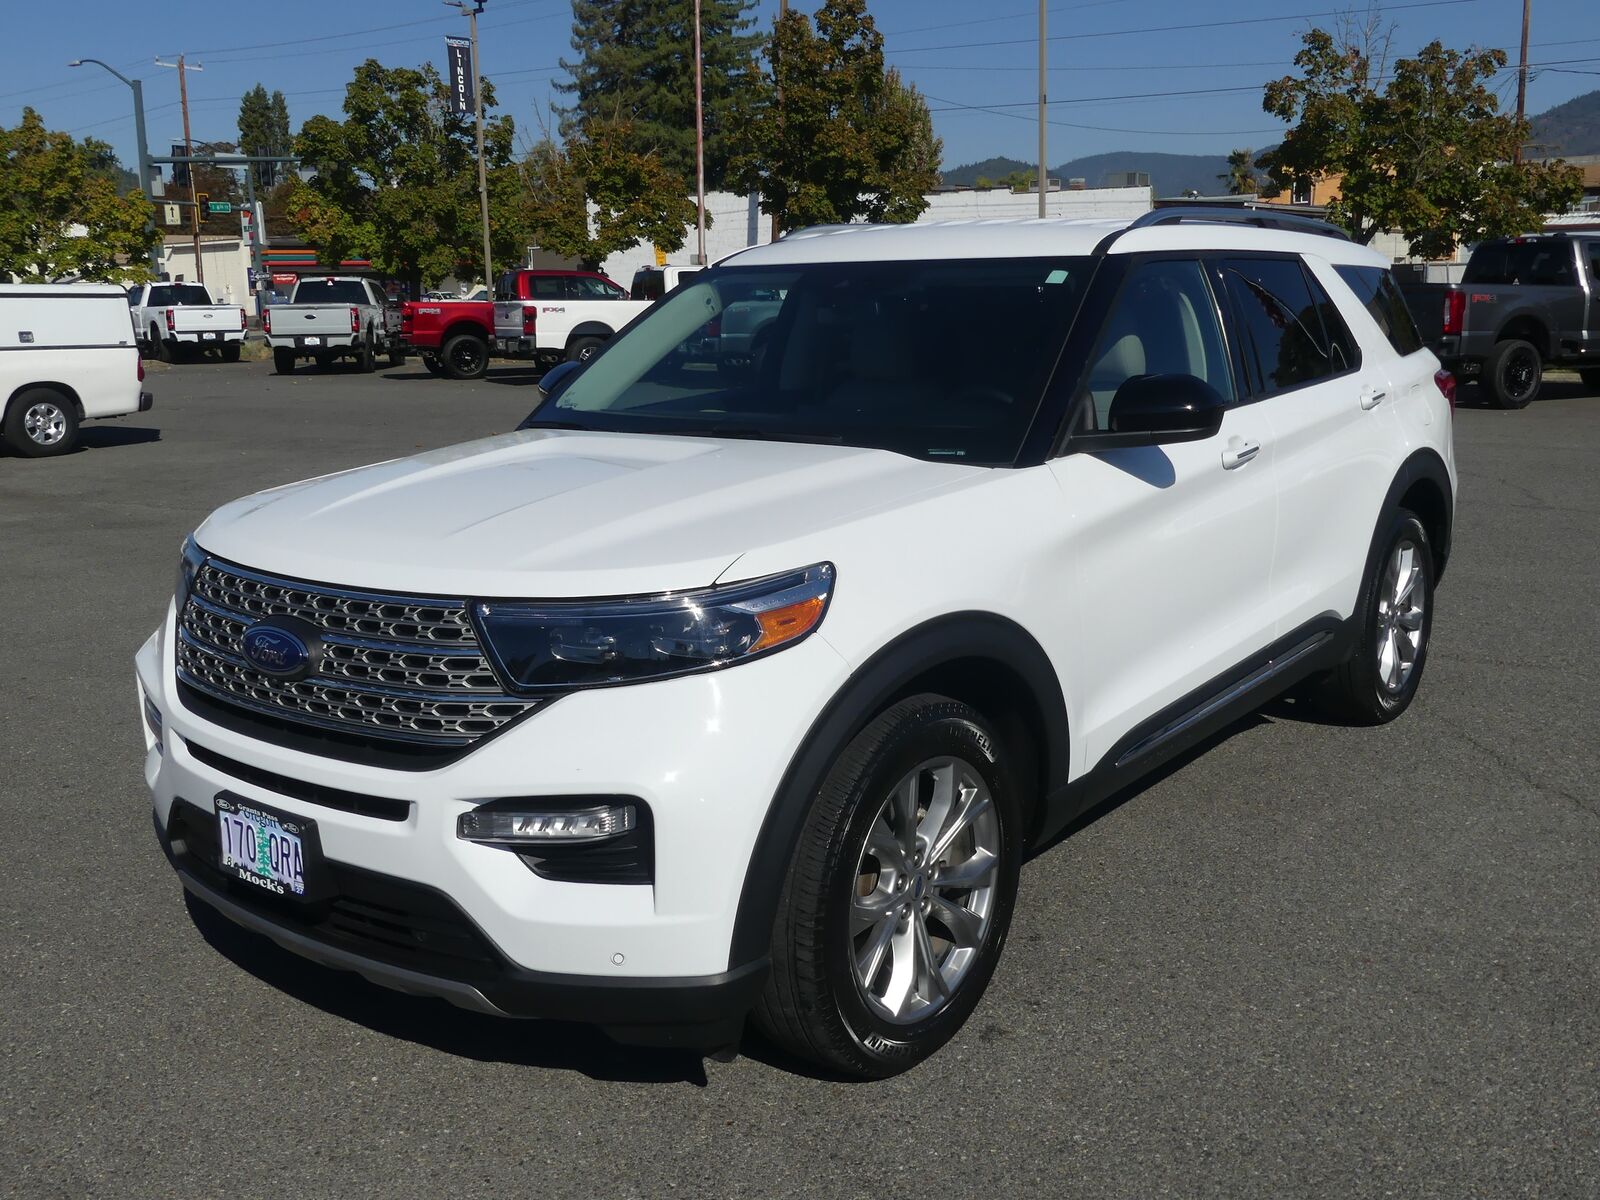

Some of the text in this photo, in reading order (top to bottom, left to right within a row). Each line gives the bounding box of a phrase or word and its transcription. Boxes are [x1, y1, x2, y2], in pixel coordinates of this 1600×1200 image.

[456, 48, 466, 111] LINCOLN
[541, 306, 566, 314] FX4
[238, 803, 279, 822] Grants Pass
[224, 816, 304, 880] 170 QRA
[239, 868, 285, 894] Mock's
